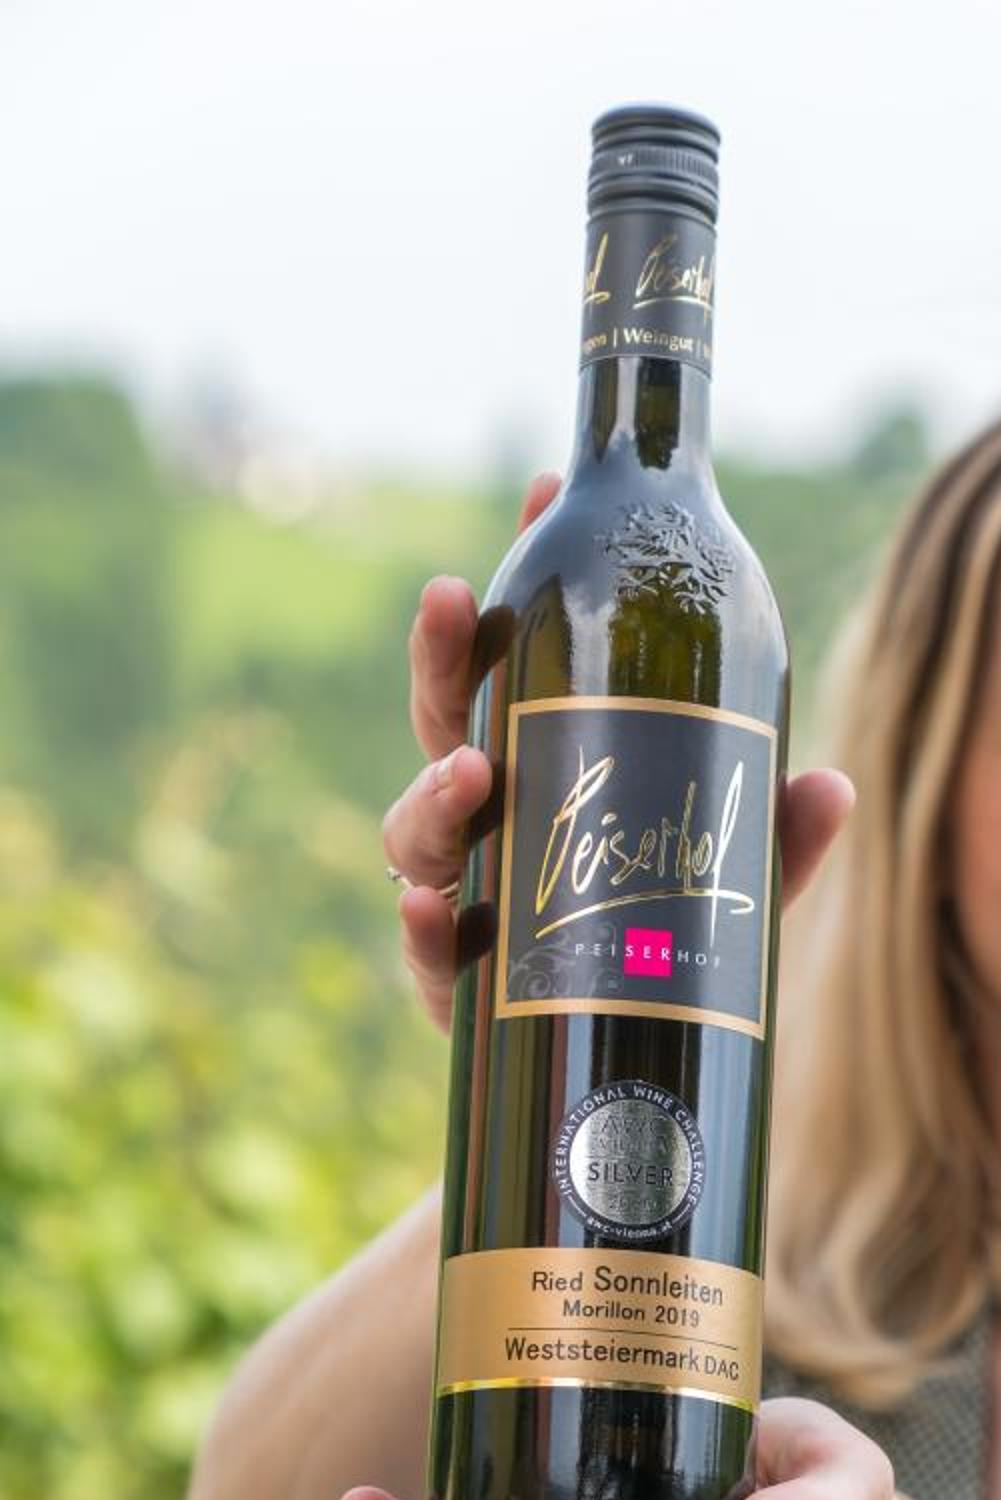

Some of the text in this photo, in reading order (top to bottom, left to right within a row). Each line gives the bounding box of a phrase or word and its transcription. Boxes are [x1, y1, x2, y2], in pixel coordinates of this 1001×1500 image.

[623, 327, 694, 352] Weingut
[555, 1085, 704, 1205] INTERNATIONAL WINE CHALLENGE
[588, 1162, 673, 1186] SILVER
[532, 1265, 723, 1305] Ried Sonnleiten
[563, 1299, 700, 1328] Morillon 2019
[505, 1336, 740, 1381] Weststeiermark DAC
